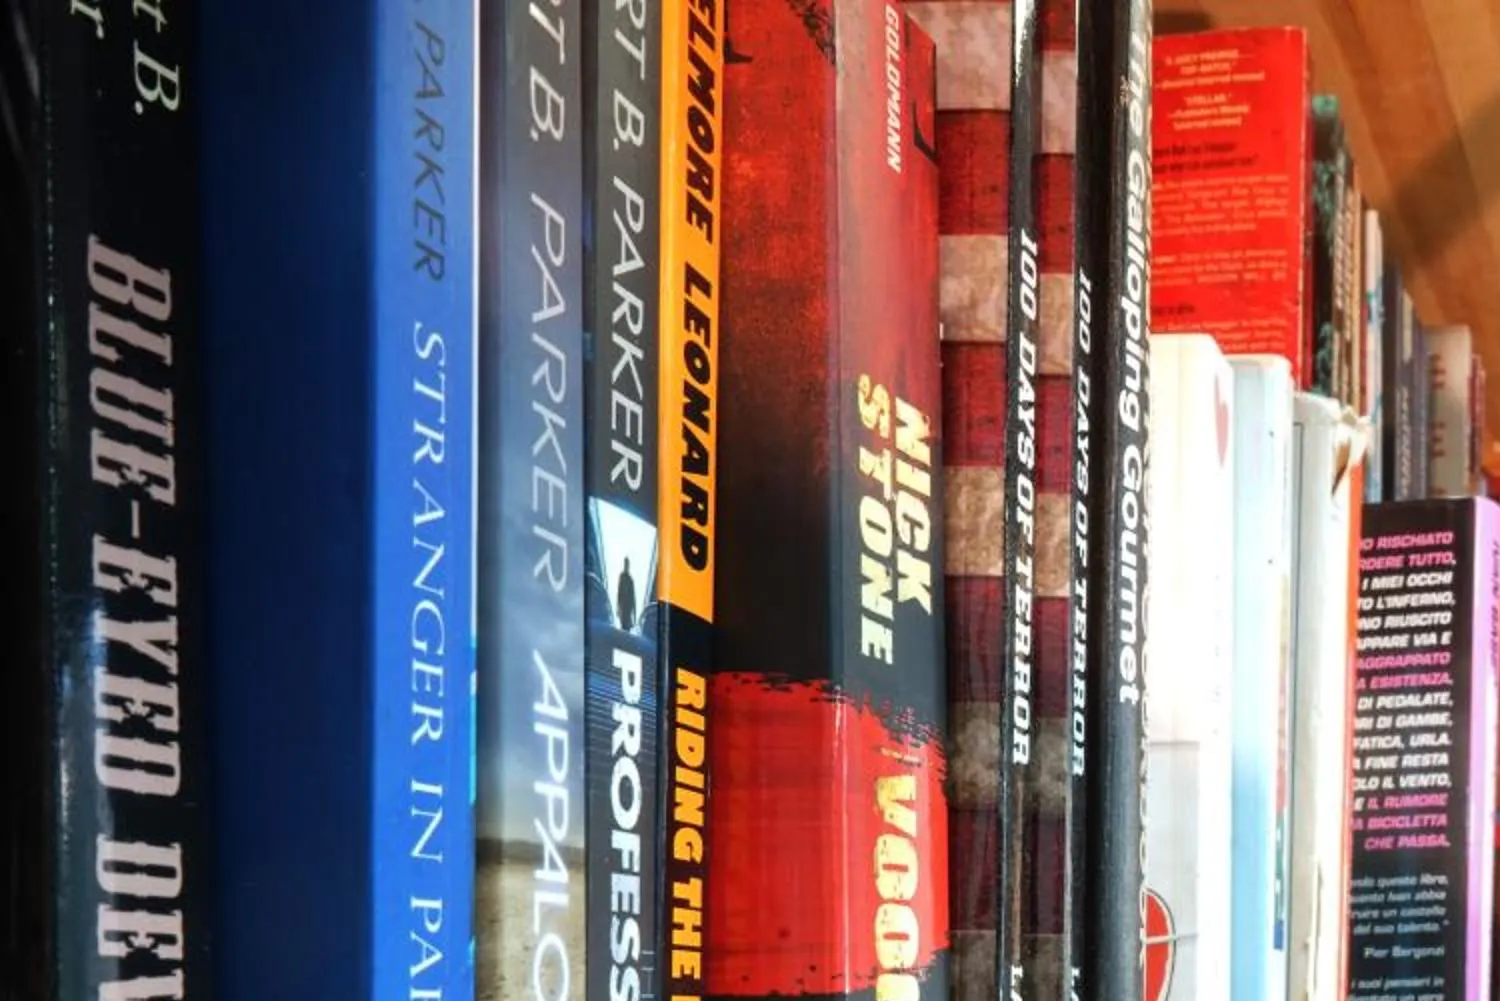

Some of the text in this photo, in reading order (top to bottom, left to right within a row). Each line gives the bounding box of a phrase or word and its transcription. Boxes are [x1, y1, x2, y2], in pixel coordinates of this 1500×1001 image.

[133, 38, 180, 115] B.
[413, 20, 446, 283] PARKER
[530, 65, 565, 141] B.
[613, 88, 645, 150] B.
[885, 4, 902, 175] GOLDMANN
[610, 175, 645, 491] PARKER
[1119, 149, 1147, 432] Galloping
[529, 192, 568, 593] PARKER
[677, 260, 713, 572] LEONARD
[86, 233, 183, 798] BLUE-EYED
[411, 320, 446, 744] STRANGER
[857, 373, 895, 665] STONE
[895, 396, 933, 616] NICK
[1012, 228, 1038, 765] 100 DAYS OF TERROR
[1072, 267, 1092, 776] 100 DAYS OF TERROR
[1119, 444, 1143, 705] Gourmet
[1359, 531, 1454, 549] O RISCHIATO
[1362, 571, 1454, 591] I MIEI OCCHI
[1357, 695, 1373, 710] DI
[1384, 610, 1453, 629] RIUSCITO
[1413, 631, 1438, 647] VIA
[1441, 630, 1453, 646] E
[672, 667, 707, 867] RIDING
[1364, 754, 1399, 770] FINE
[1401, 751, 1450, 769] RESTA
[1376, 714, 1392, 729] DI
[410, 780, 444, 865] IN
[1366, 812, 1448, 830] BICICLETTA
[671, 876, 704, 981] THE
